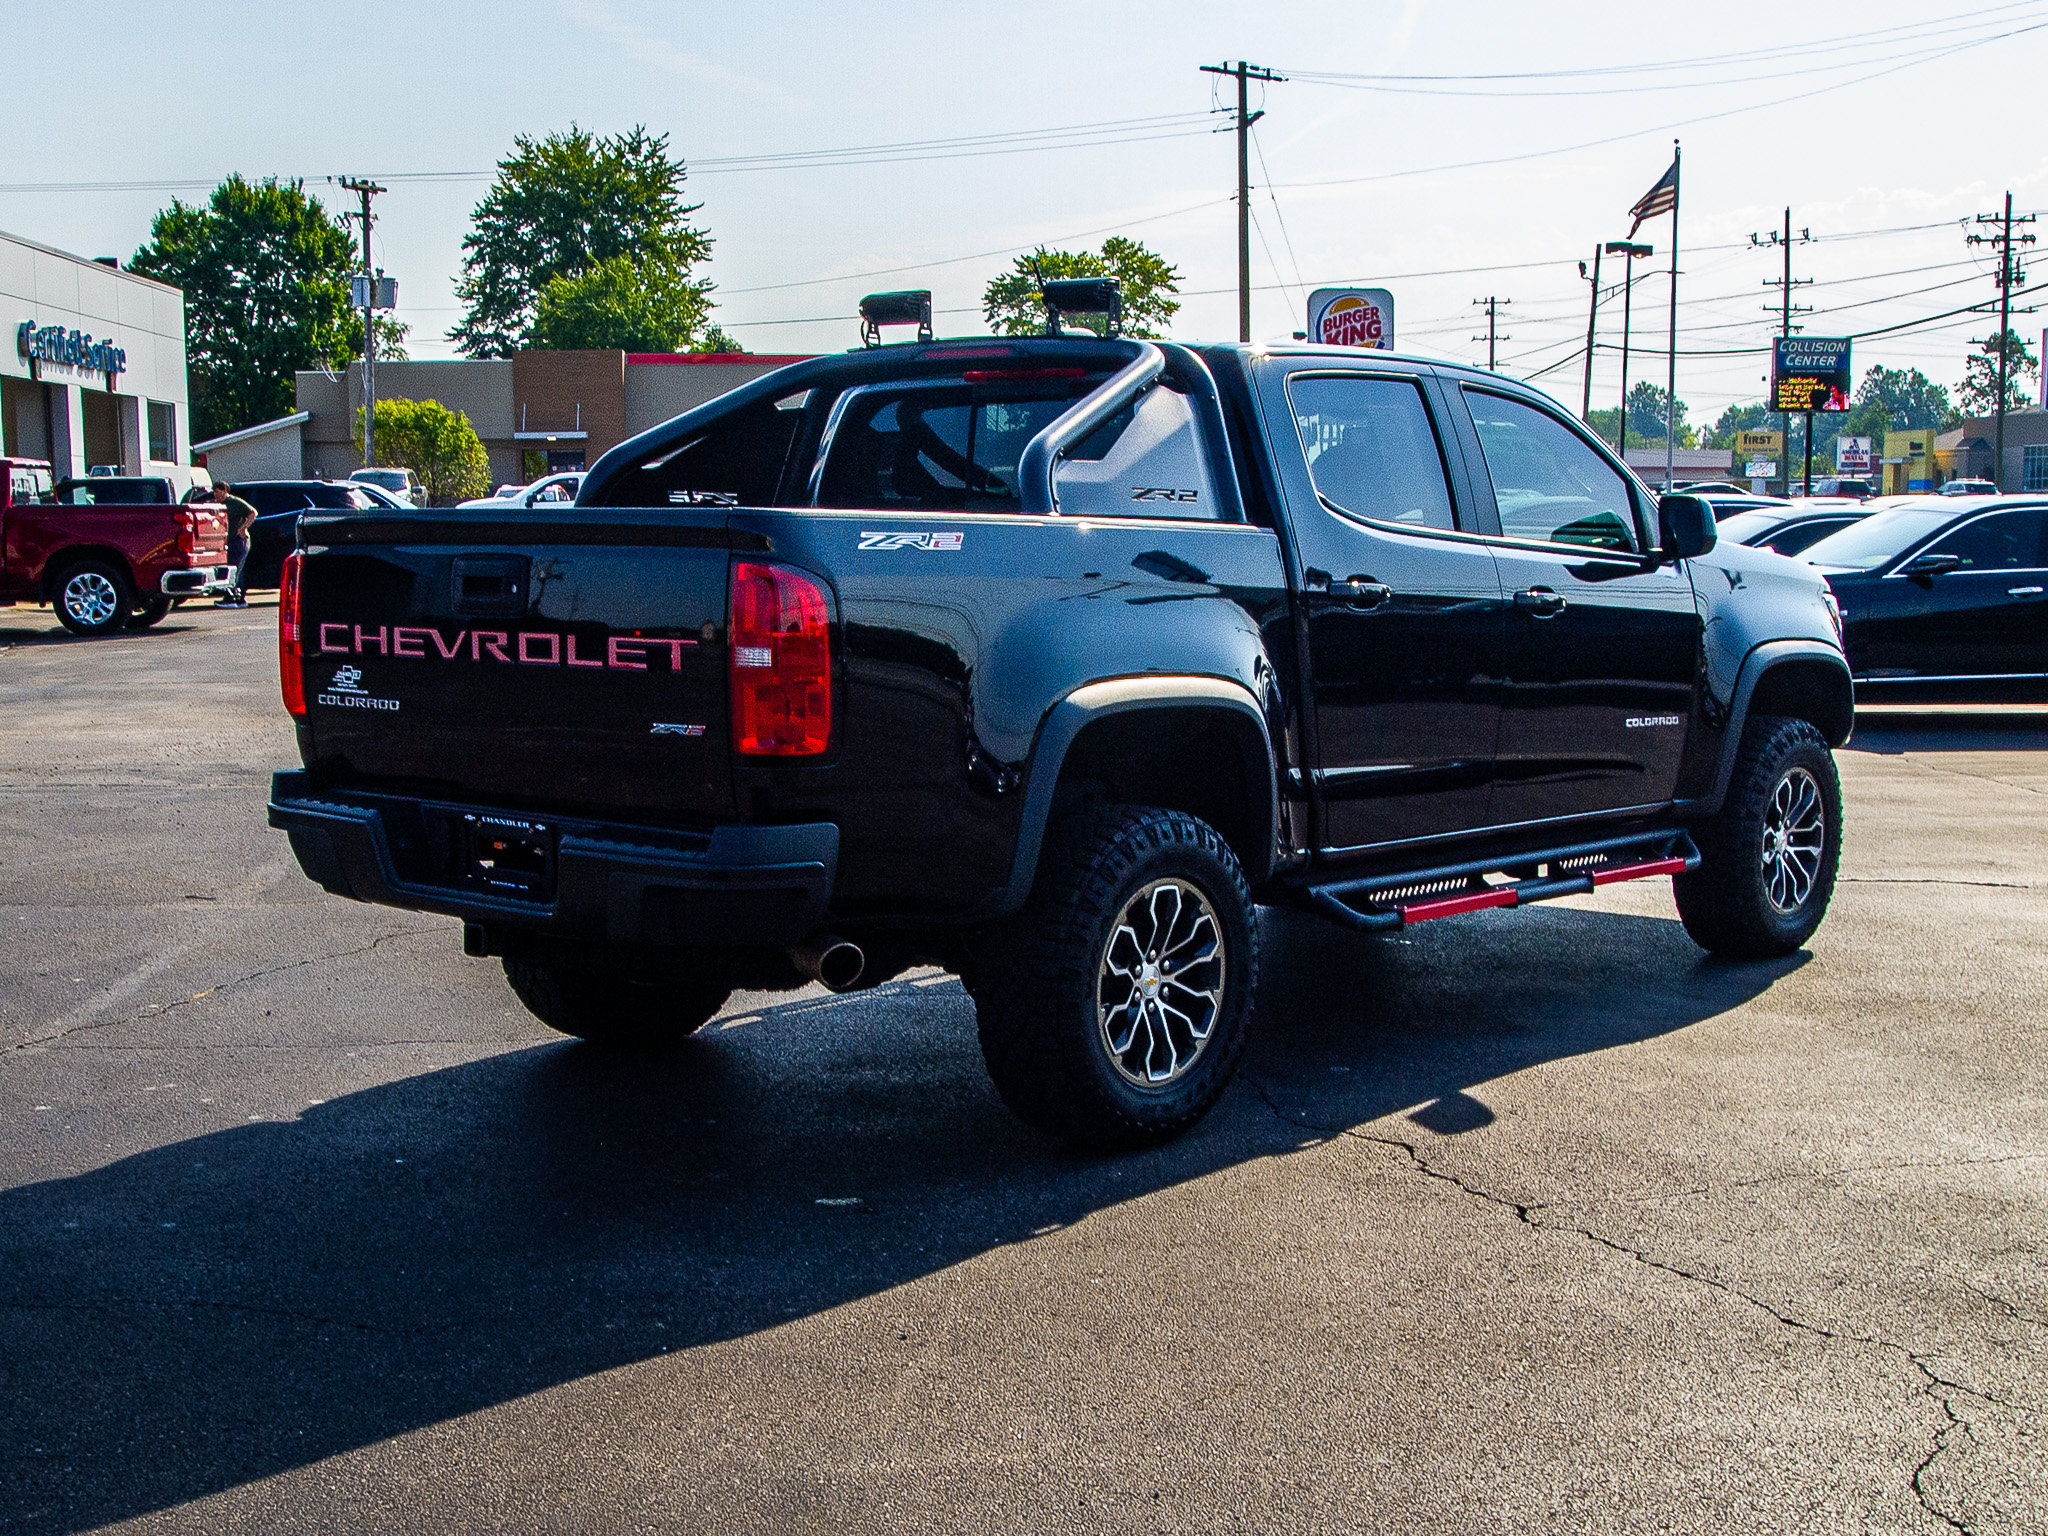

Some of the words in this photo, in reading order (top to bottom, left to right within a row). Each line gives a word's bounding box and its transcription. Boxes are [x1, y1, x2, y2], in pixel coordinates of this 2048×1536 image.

[1323, 306, 1380, 333] BURGER
[1325, 320, 1382, 345] KING
[82, 333, 126, 373] Service
[1780, 341, 1846, 352] COLLISION
[1786, 354, 1836, 366] CENTER
[1131, 487, 1198, 503] ZR2
[857, 531, 965, 550] ZR2
[320, 623, 698, 672] CHEVROLET
[318, 694, 400, 711] COLORADO
[650, 723, 706, 736] ZR2
[1626, 716, 1679, 727] COLORADO
[481, 816, 530, 829] CHANDLER
